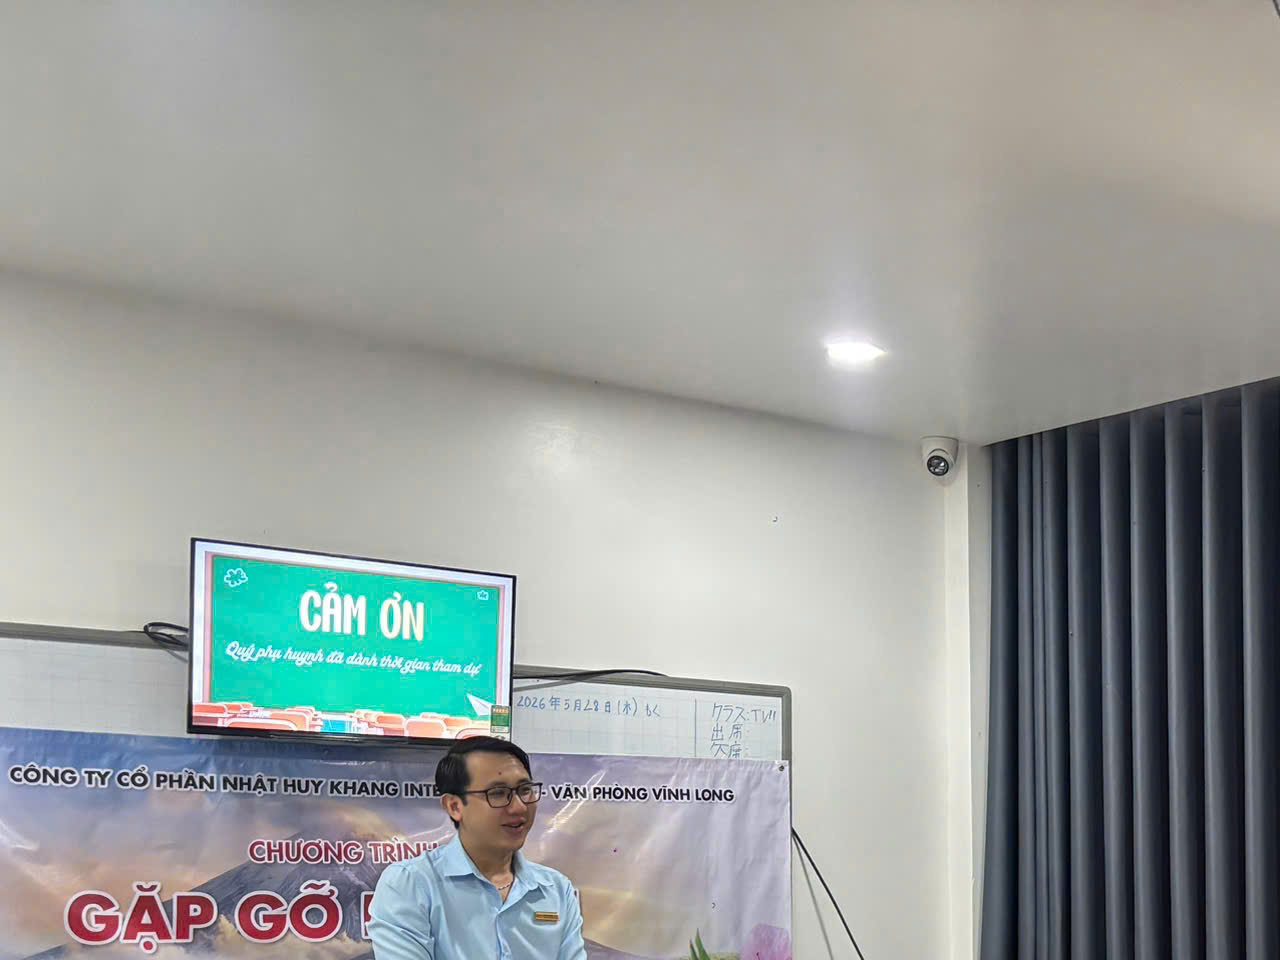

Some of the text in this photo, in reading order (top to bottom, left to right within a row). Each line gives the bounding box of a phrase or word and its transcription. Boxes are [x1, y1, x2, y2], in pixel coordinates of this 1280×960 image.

[300, 581, 367, 636] CẢM
[225, 640, 258, 662] Quý
[256, 644, 282, 662] phụ
[283, 646, 324, 667] huynh
[326, 650, 345, 664] đã
[345, 651, 378, 667] dành
[400, 657, 431, 674] gian
[432, 658, 461, 673] tham
[9, 763, 78, 785] CÔNG
[84, 770, 111, 786] TY
[116, 766, 149, 787] CỔ
[155, 769, 215, 790] PHẦN
[222, 774, 278, 796] NHẬT
[283, 778, 324, 794] HUY
[329, 780, 399, 797] KHANG
[550, 784, 587, 800] VĂN
[592, 784, 648, 801] PHÒNG
[652, 785, 691, 801] VĨNH
[695, 788, 735, 802] LONG
[249, 840, 363, 864] CHƯƠNG
[66, 883, 215, 953] GẶP
[237, 882, 342, 941] GỠ
